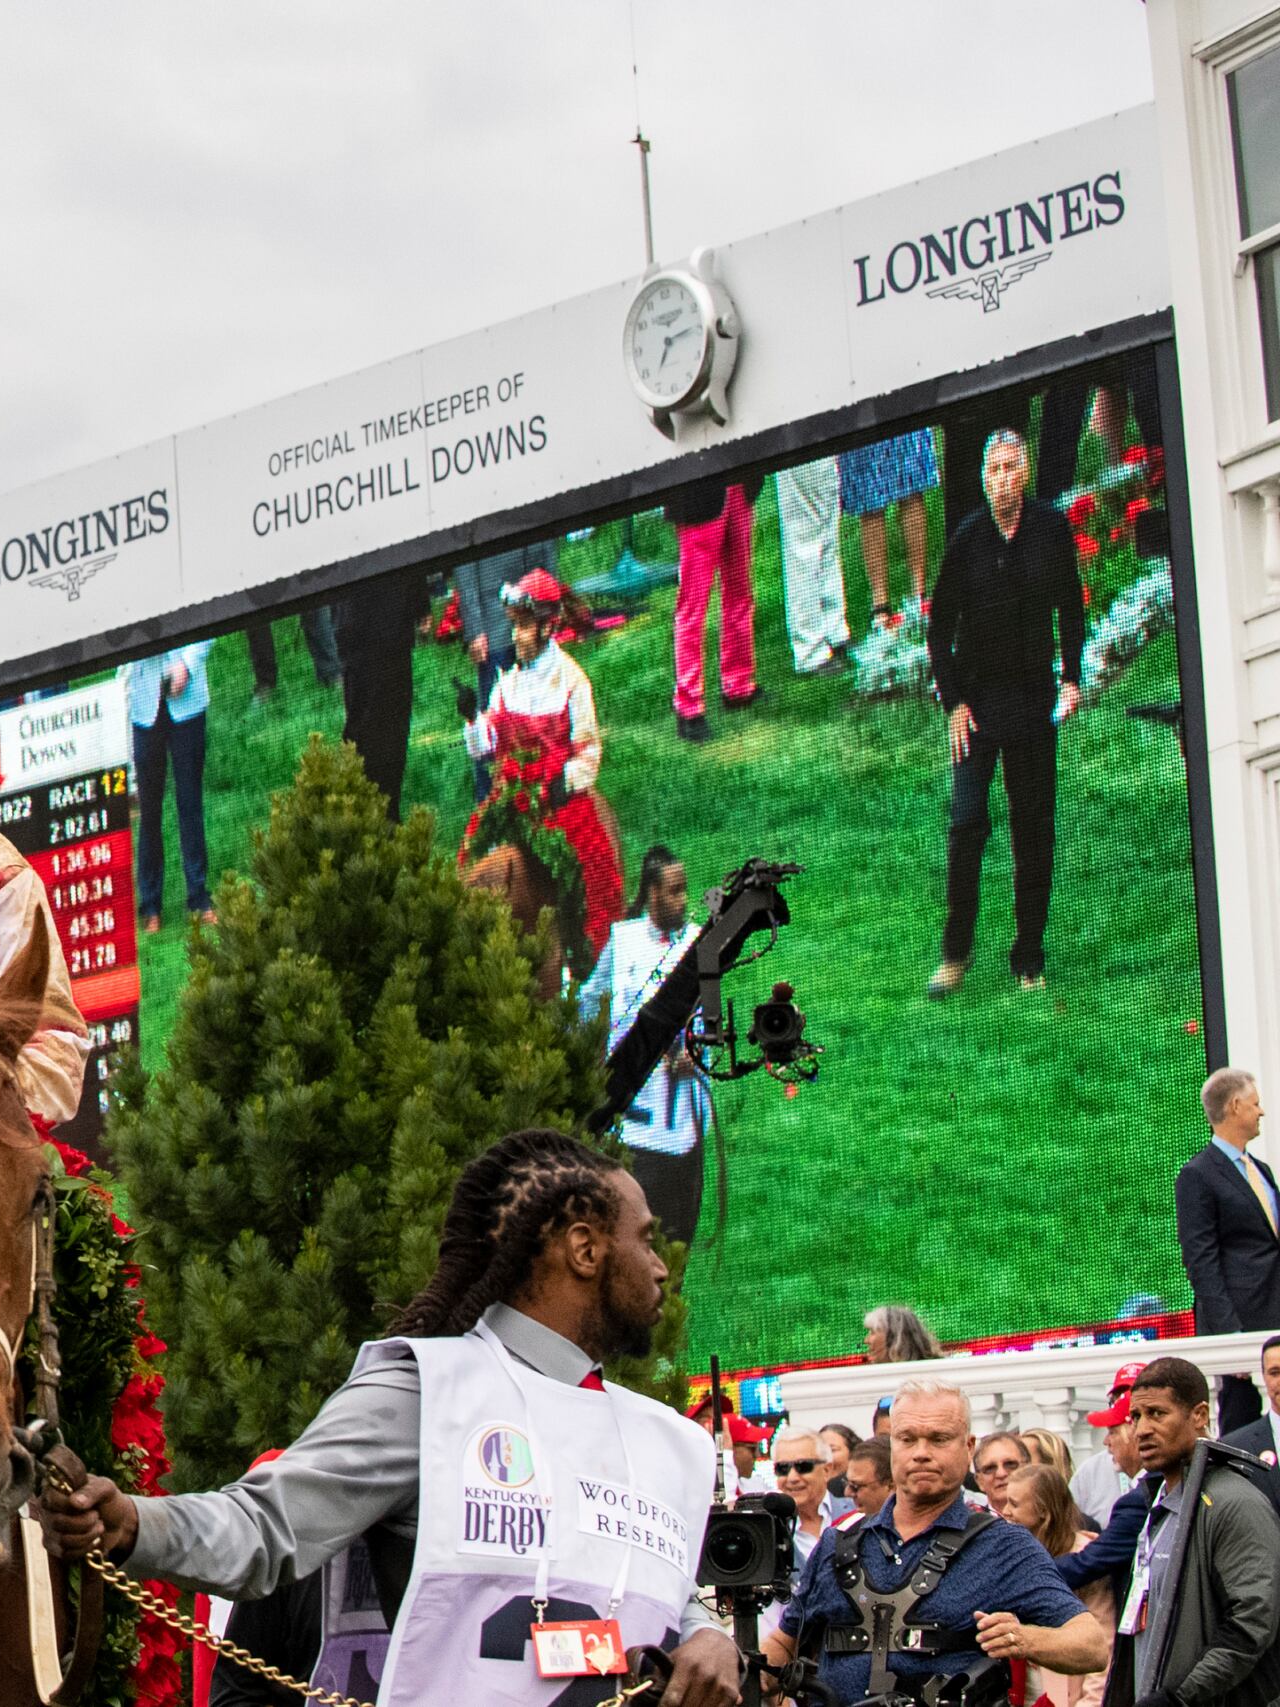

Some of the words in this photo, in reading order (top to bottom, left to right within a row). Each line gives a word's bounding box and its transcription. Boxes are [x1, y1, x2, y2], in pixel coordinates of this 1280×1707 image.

[853, 170, 1125, 307] LONGINES
[269, 430, 355, 476] OFFICIAL
[360, 385, 490, 447] TIMEKEEPER
[497, 372, 525, 402] OF
[253, 458, 420, 536] CHURCHILL
[432, 415, 547, 482] DOWNS
[48, 779, 96, 810] RACE
[101, 768, 126, 796] 12
[53, 875, 113, 909] 1:10.34
[464, 1486, 537, 1506] KENTUCKY
[579, 1481, 687, 1542] WOODFORD
[463, 1501, 552, 1555] DERBY
[596, 1513, 686, 1567] RESERVE
